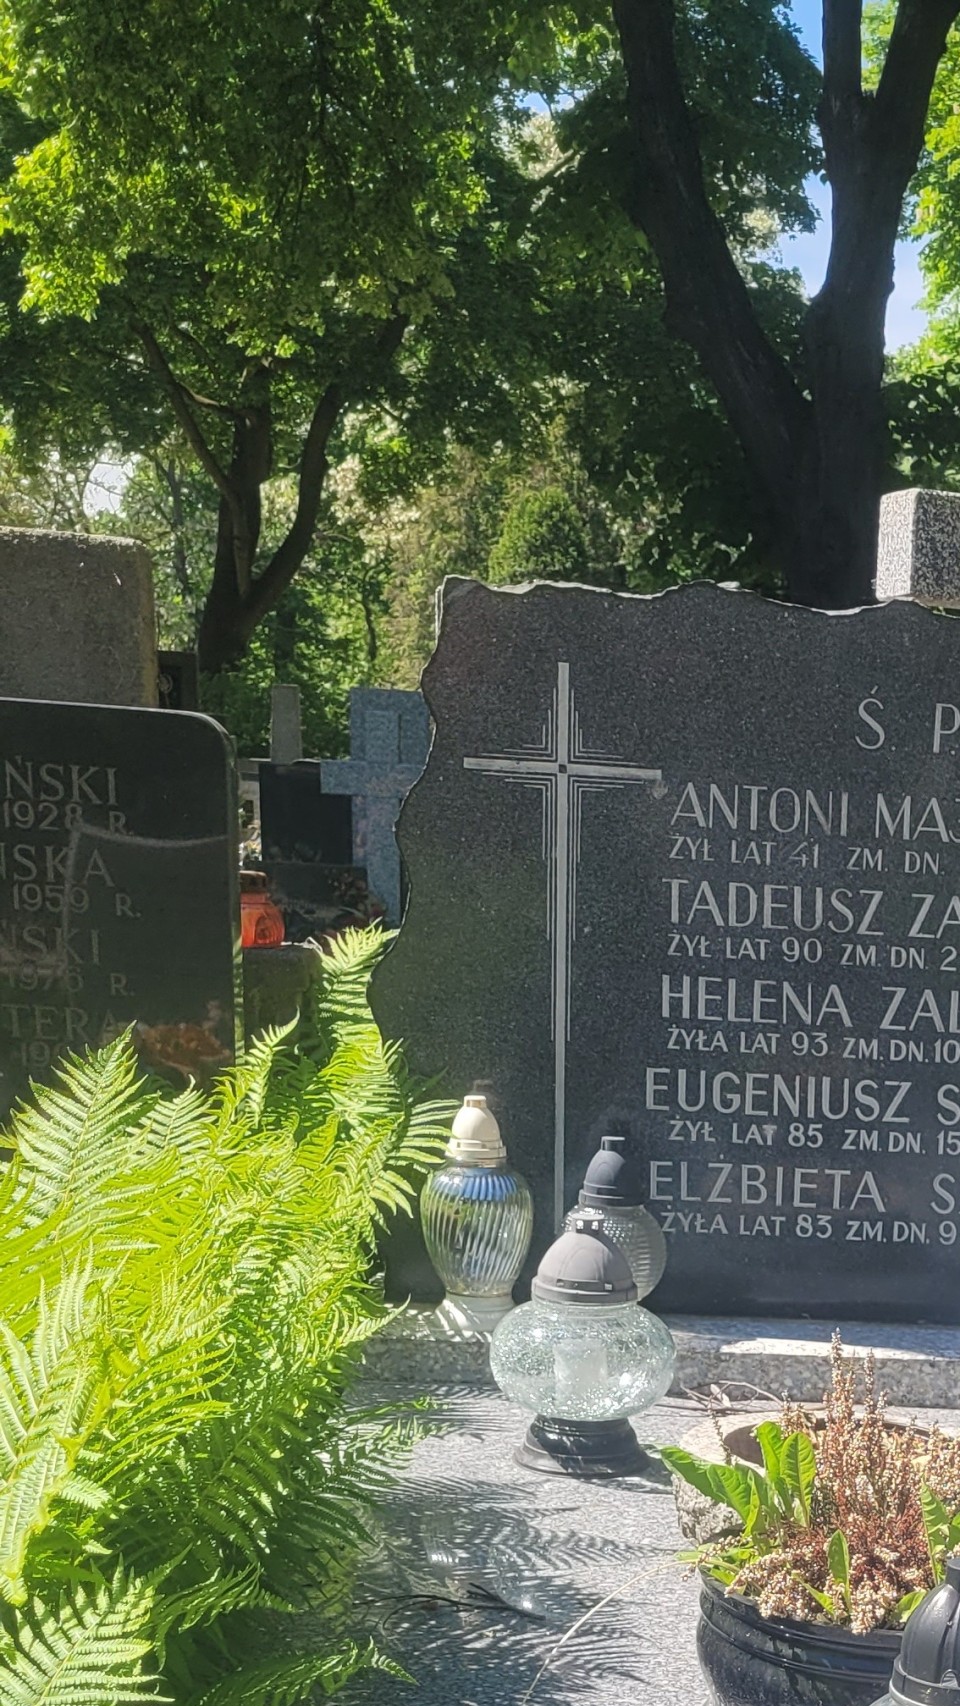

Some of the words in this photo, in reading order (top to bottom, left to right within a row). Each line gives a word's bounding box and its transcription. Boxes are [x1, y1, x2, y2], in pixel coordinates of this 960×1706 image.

[670, 782, 848, 837] ANTONI
[0, 842, 117, 888] SKA
[668, 832, 714, 861] ŻYŁ
[731, 839, 777, 866] LAT
[789, 840, 819, 868] 41
[846, 847, 888, 872] ZM.
[904, 850, 945, 876] DN.
[662, 878, 884, 935] TADEUSZ
[667, 929, 712, 958] ŻYŁ
[726, 937, 770, 961] LAT
[782, 936, 823, 963] 90
[840, 943, 881, 967] ZM.
[891, 946, 928, 970] DN.
[661, 974, 853, 1028] HELENA
[667, 1024, 728, 1052] ŻYŁA
[740, 1031, 780, 1055] LAT
[791, 1031, 829, 1057] 93
[842, 1037, 884, 1061] ZM.
[889, 1039, 929, 1063] DN.
[646, 1067, 912, 1123] EUGENIUSZ
[668, 1114, 716, 1143] ŻYŁ
[732, 1122, 778, 1146] LAT
[788, 1122, 824, 1148] 85
[841, 1129, 882, 1152] ZM.
[888, 1131, 926, 1154] DN.
[650, 1154, 886, 1213] ELŻBIETA
[661, 1205, 728, 1235] ŻYŁA
[739, 1214, 786, 1236] LAT
[796, 1214, 832, 1239] 83
[845, 1220, 887, 1243] ZM.
[893, 1220, 930, 1245] DN.
